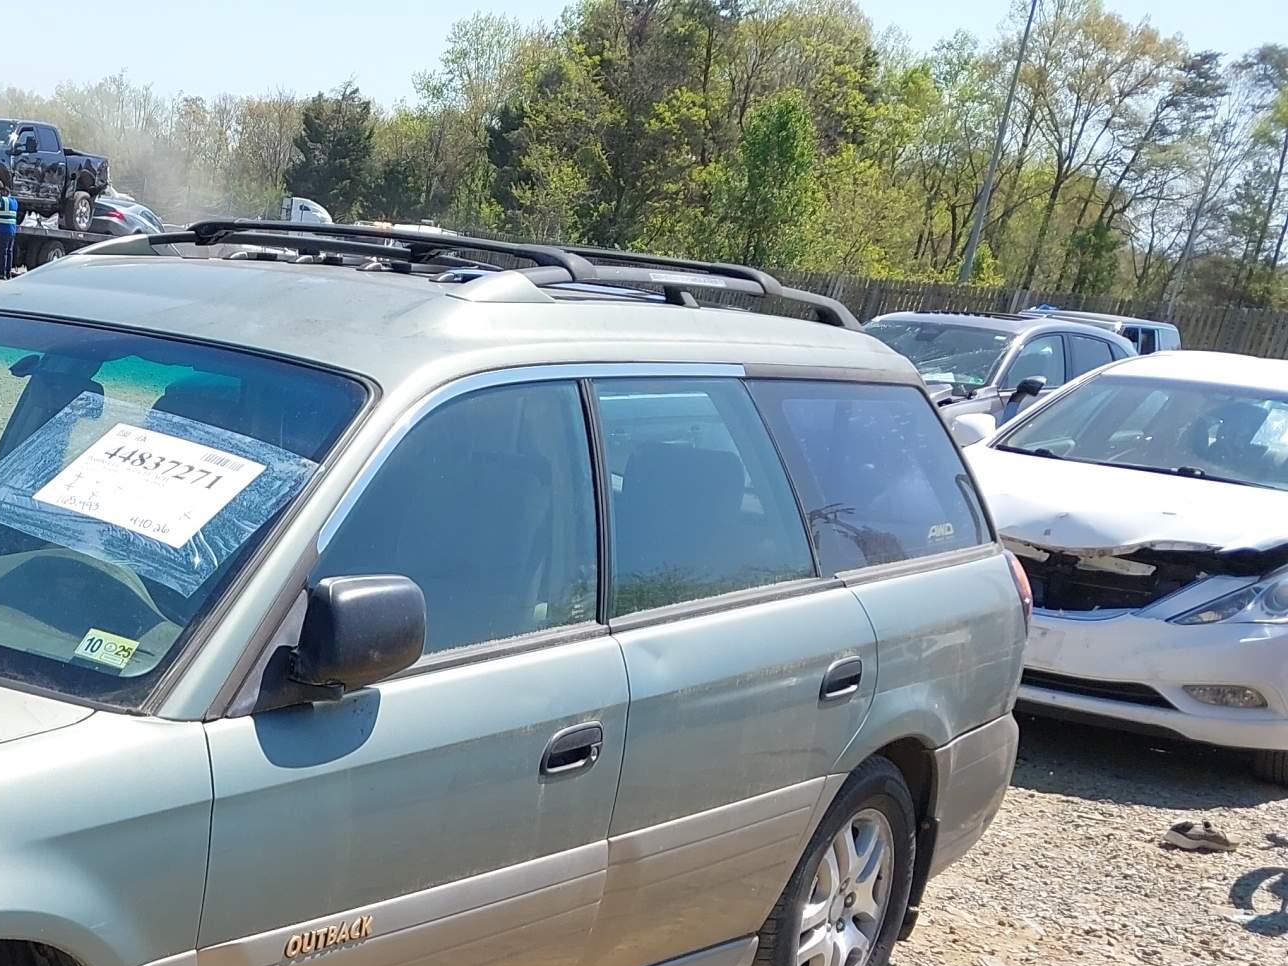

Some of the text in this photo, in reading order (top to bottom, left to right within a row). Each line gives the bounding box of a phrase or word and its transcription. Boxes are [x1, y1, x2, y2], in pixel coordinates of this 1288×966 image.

[104, 445, 224, 490] 44837271
[928, 522, 954, 539] AWD
[84, 636, 133, 658] 10 25
[284, 915, 373, 958] OUTBACK
